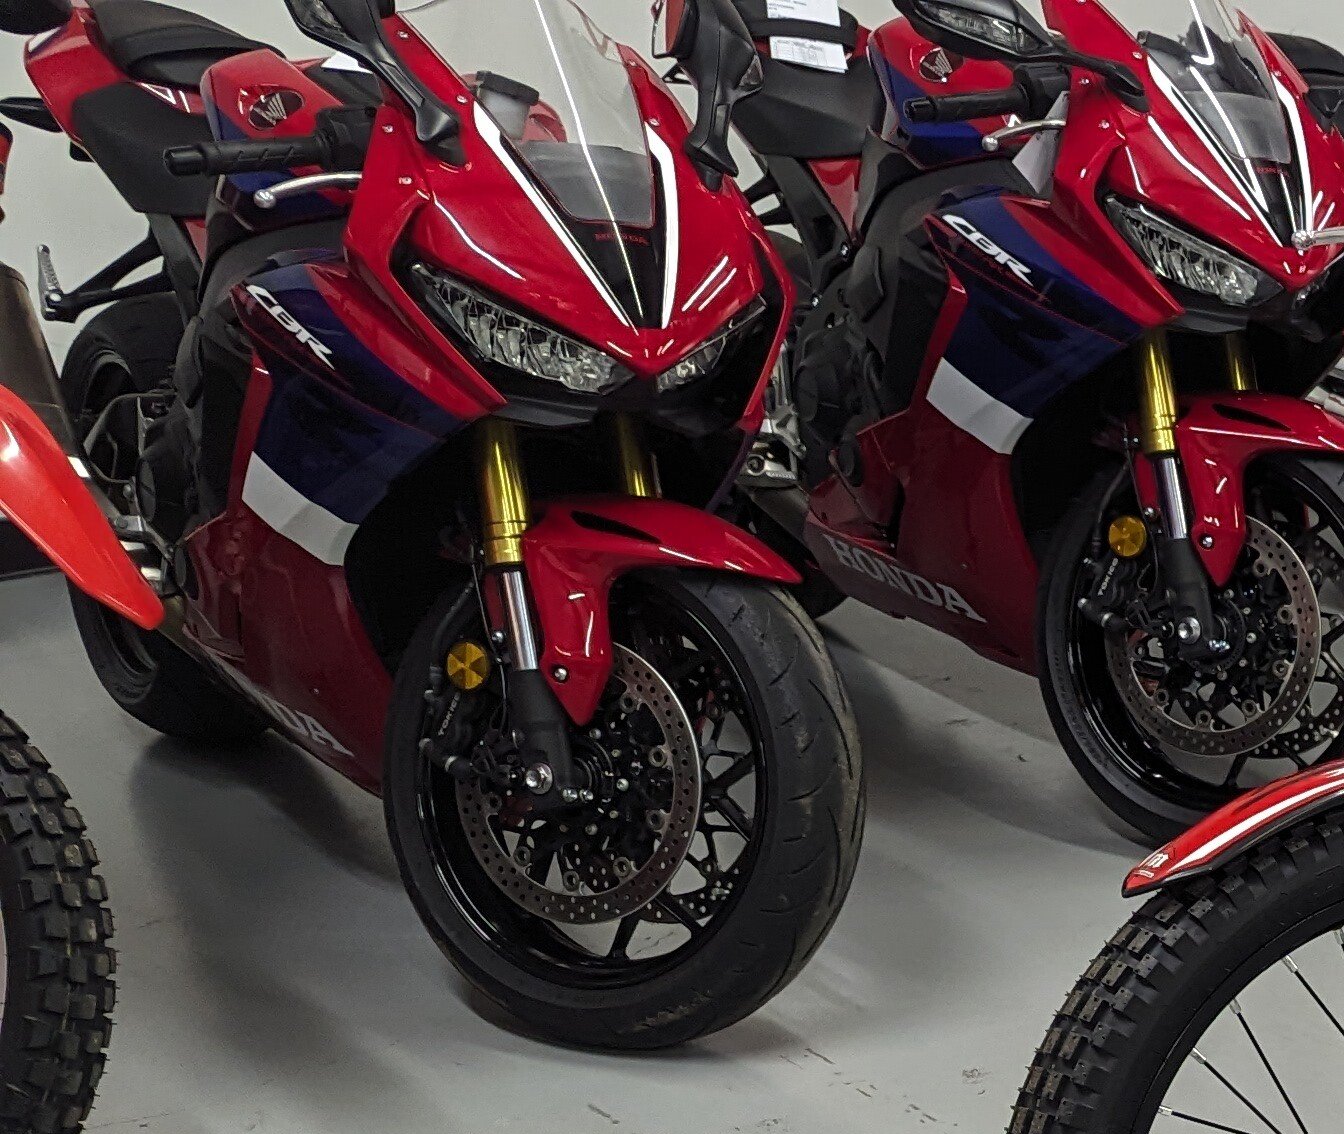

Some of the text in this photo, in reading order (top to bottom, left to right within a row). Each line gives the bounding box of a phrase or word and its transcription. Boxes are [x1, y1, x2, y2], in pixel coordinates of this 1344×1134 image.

[942, 214, 1034, 287] CBR
[246, 285, 335, 370] CBR
[821, 533, 988, 624] HONDA
